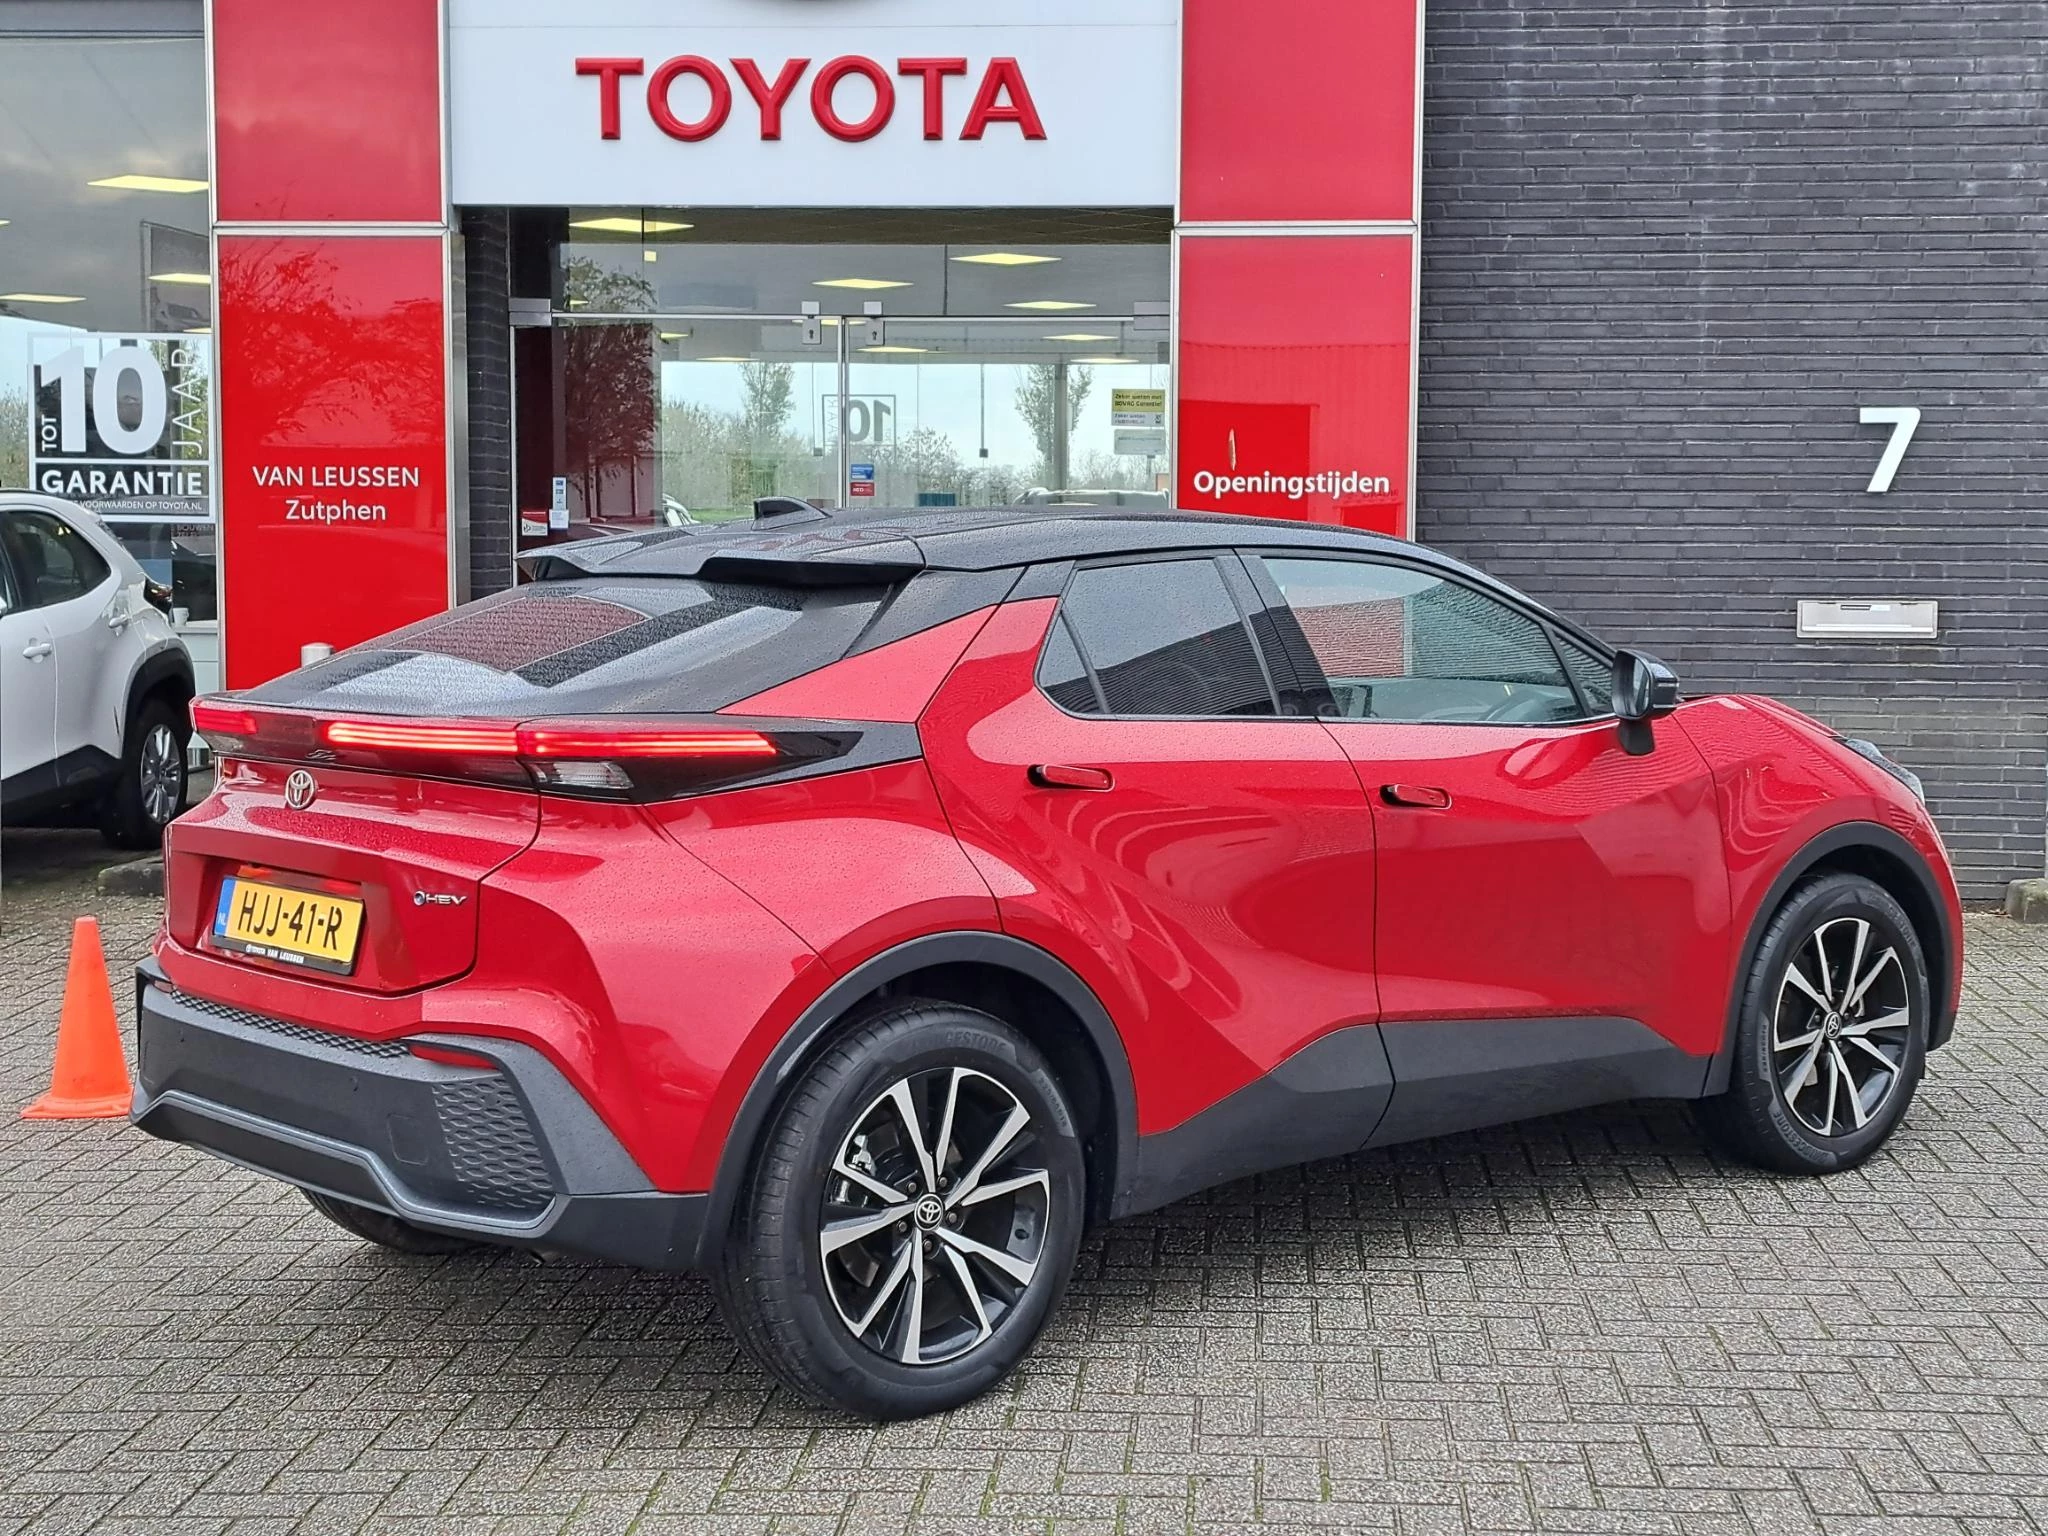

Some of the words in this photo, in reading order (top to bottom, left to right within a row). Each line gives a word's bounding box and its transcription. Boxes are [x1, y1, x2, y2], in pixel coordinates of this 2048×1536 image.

[575, 54, 1048, 143] TOYOTA
[40, 346, 167, 454] 10
[41, 414, 57, 452] TOT
[1859, 407, 1921, 492] 7
[41, 469, 202, 495] GARANTIE
[252, 466, 303, 486] VAN
[312, 466, 419, 487] LEUSSEN
[1193, 470, 1390, 500] Openingstijden
[80, 501, 143, 509] VOORWAARDEN
[145, 501, 157, 510] OP
[159, 501, 202, 510] TOYOTA.NL
[285, 499, 386, 525] Zutphen
[426, 894, 467, 905] HEV
[217, 912, 226, 925] NL
[238, 890, 342, 950] HJJ-41-R
